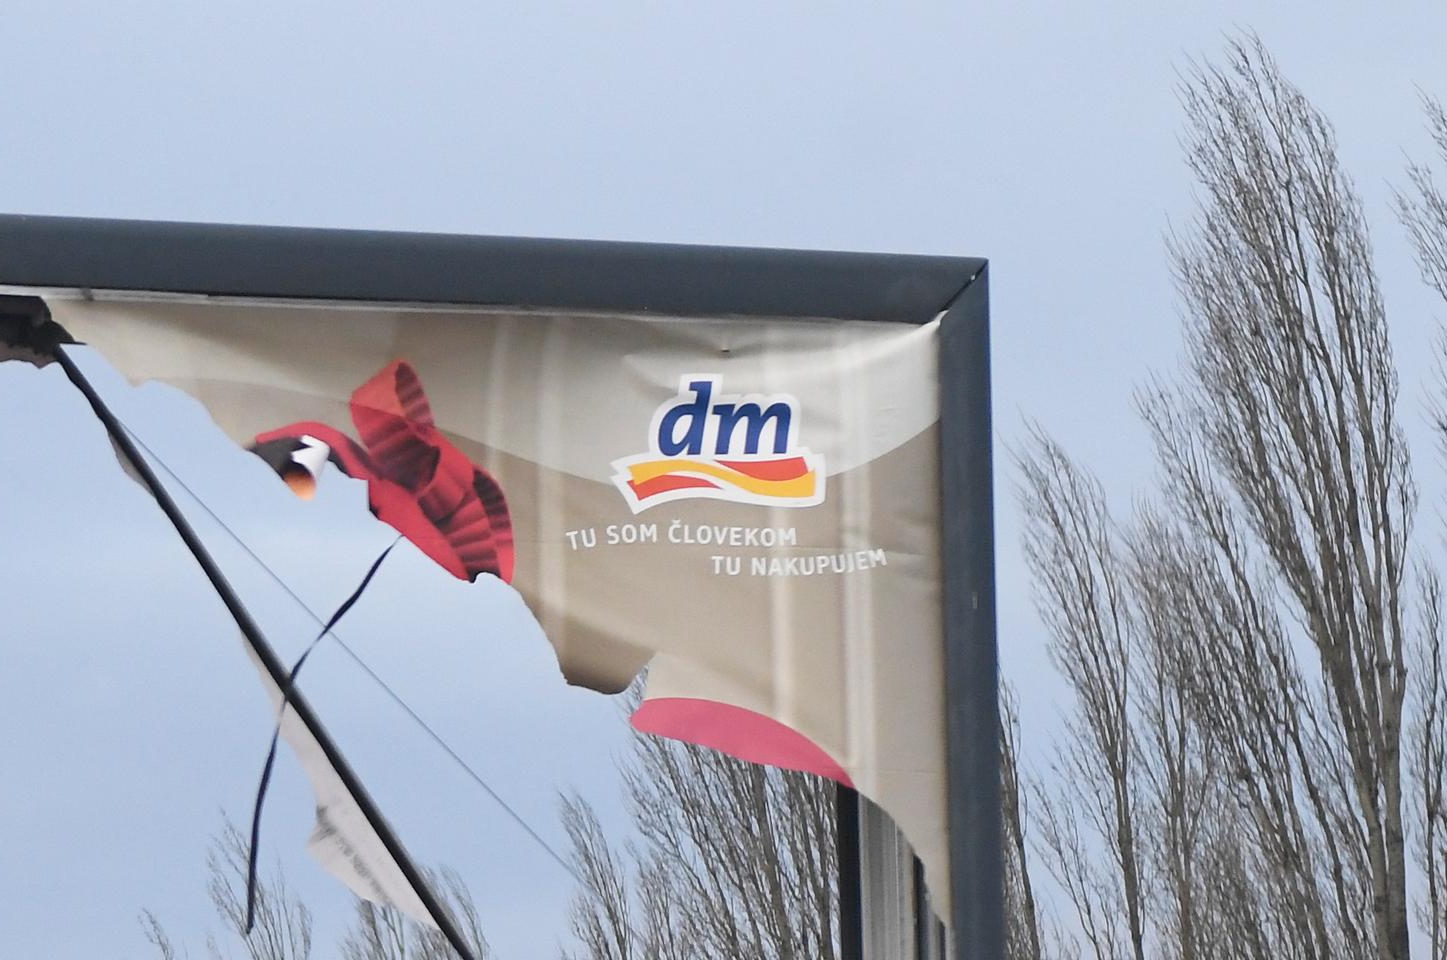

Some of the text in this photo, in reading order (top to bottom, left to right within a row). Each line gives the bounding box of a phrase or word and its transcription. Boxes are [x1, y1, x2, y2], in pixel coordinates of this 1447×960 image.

[657, 380, 792, 457] dm
[565, 519, 798, 551] TU SOM ČLOVEKOM
[711, 548, 889, 577] TU NAKUPUJEM
